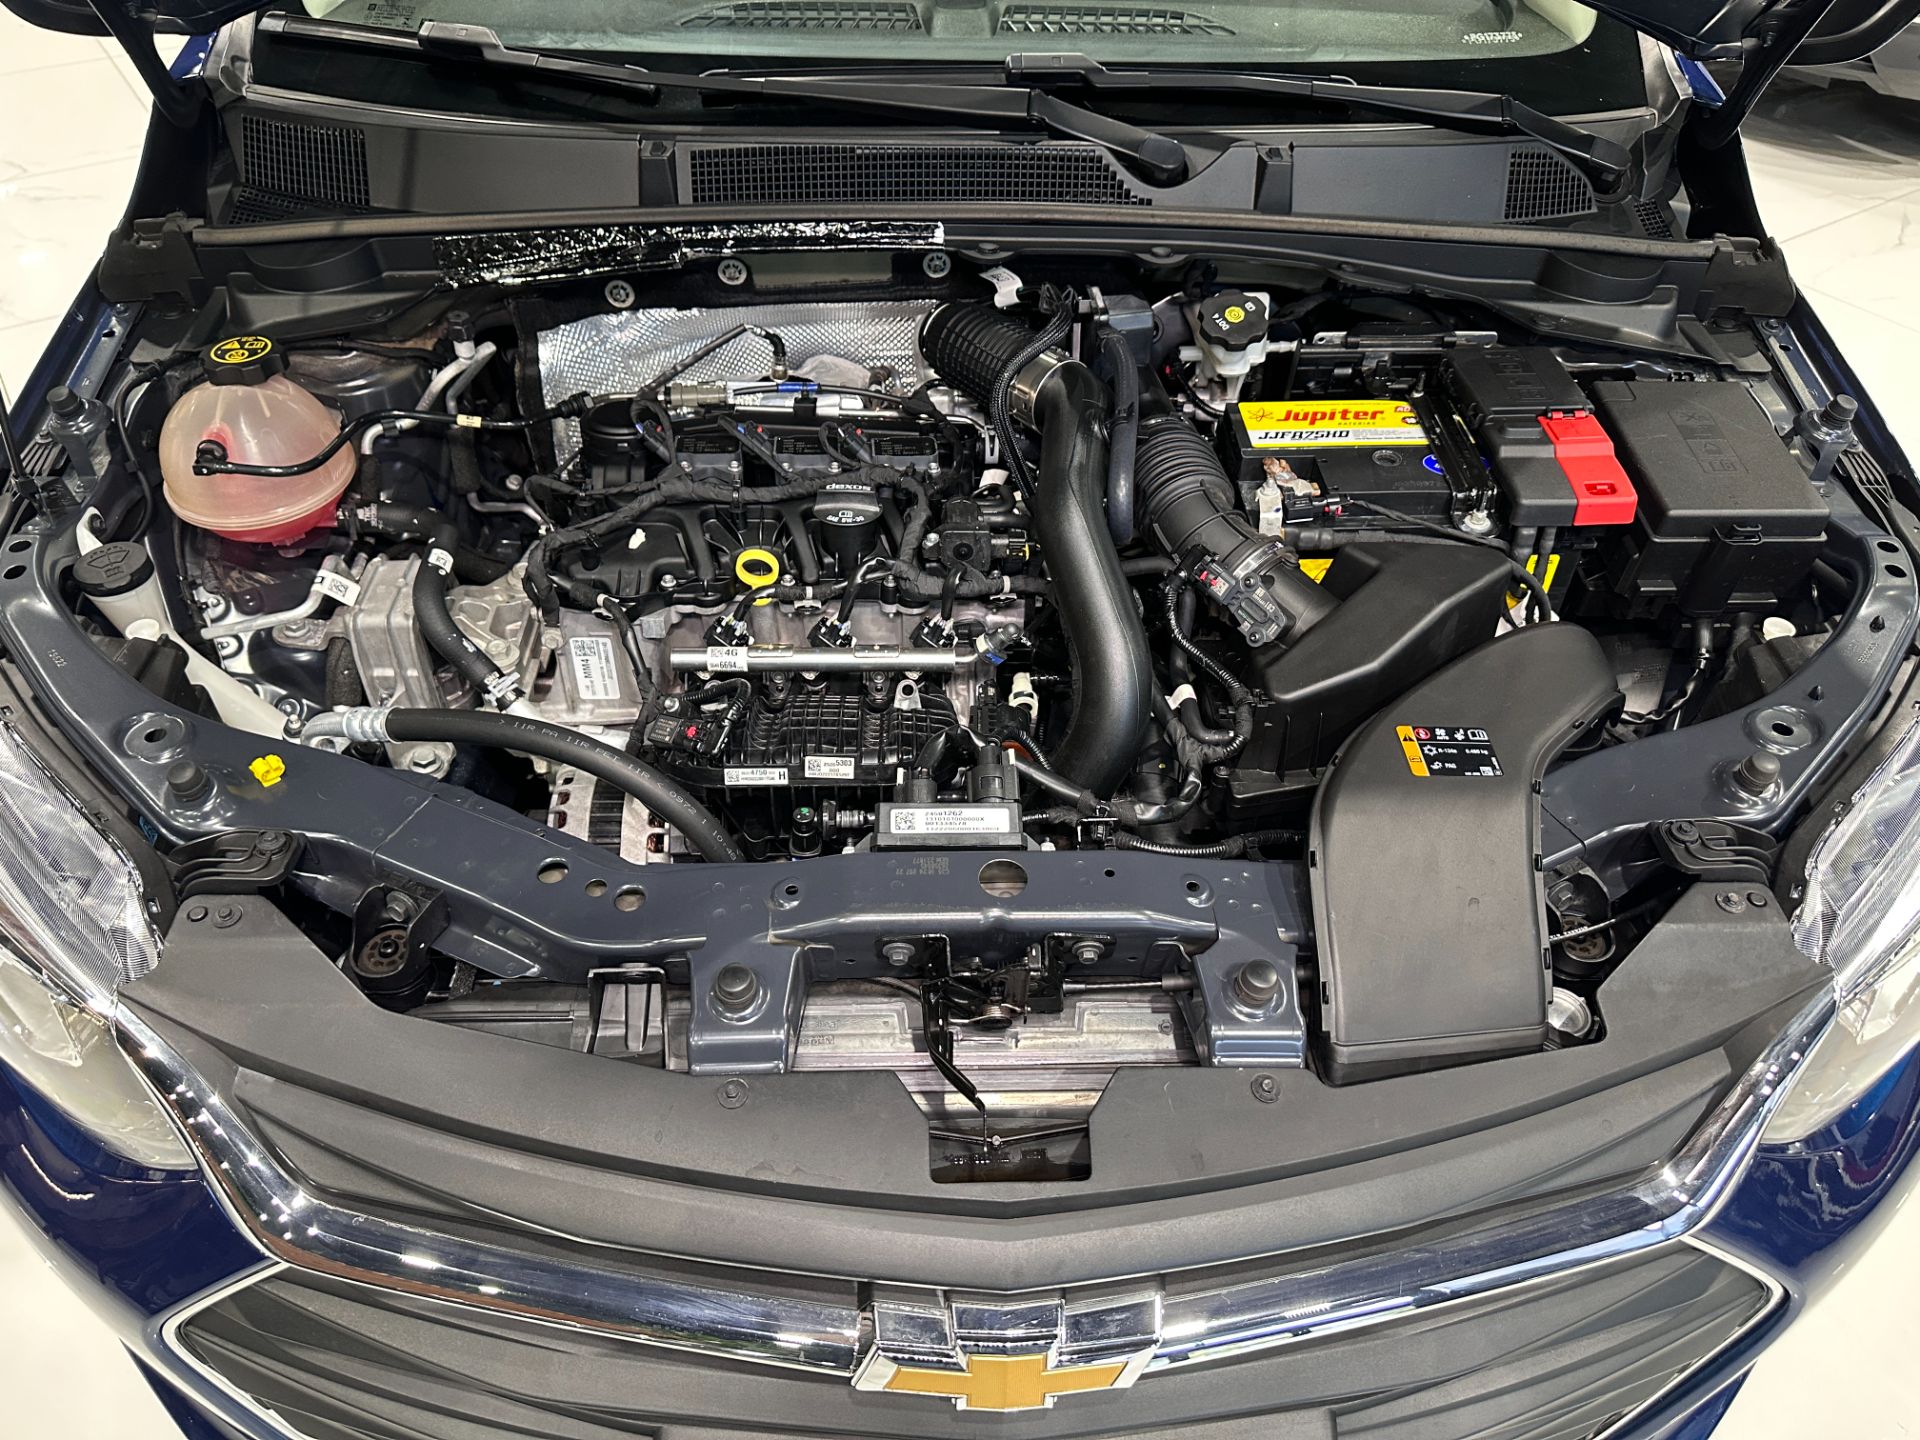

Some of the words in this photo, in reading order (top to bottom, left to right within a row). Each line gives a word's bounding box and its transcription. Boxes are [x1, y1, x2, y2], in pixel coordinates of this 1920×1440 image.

[1215, 318, 1230, 331] DOT
[1276, 409, 1385, 426] Jupiter
[778, 771, 786, 780] H
